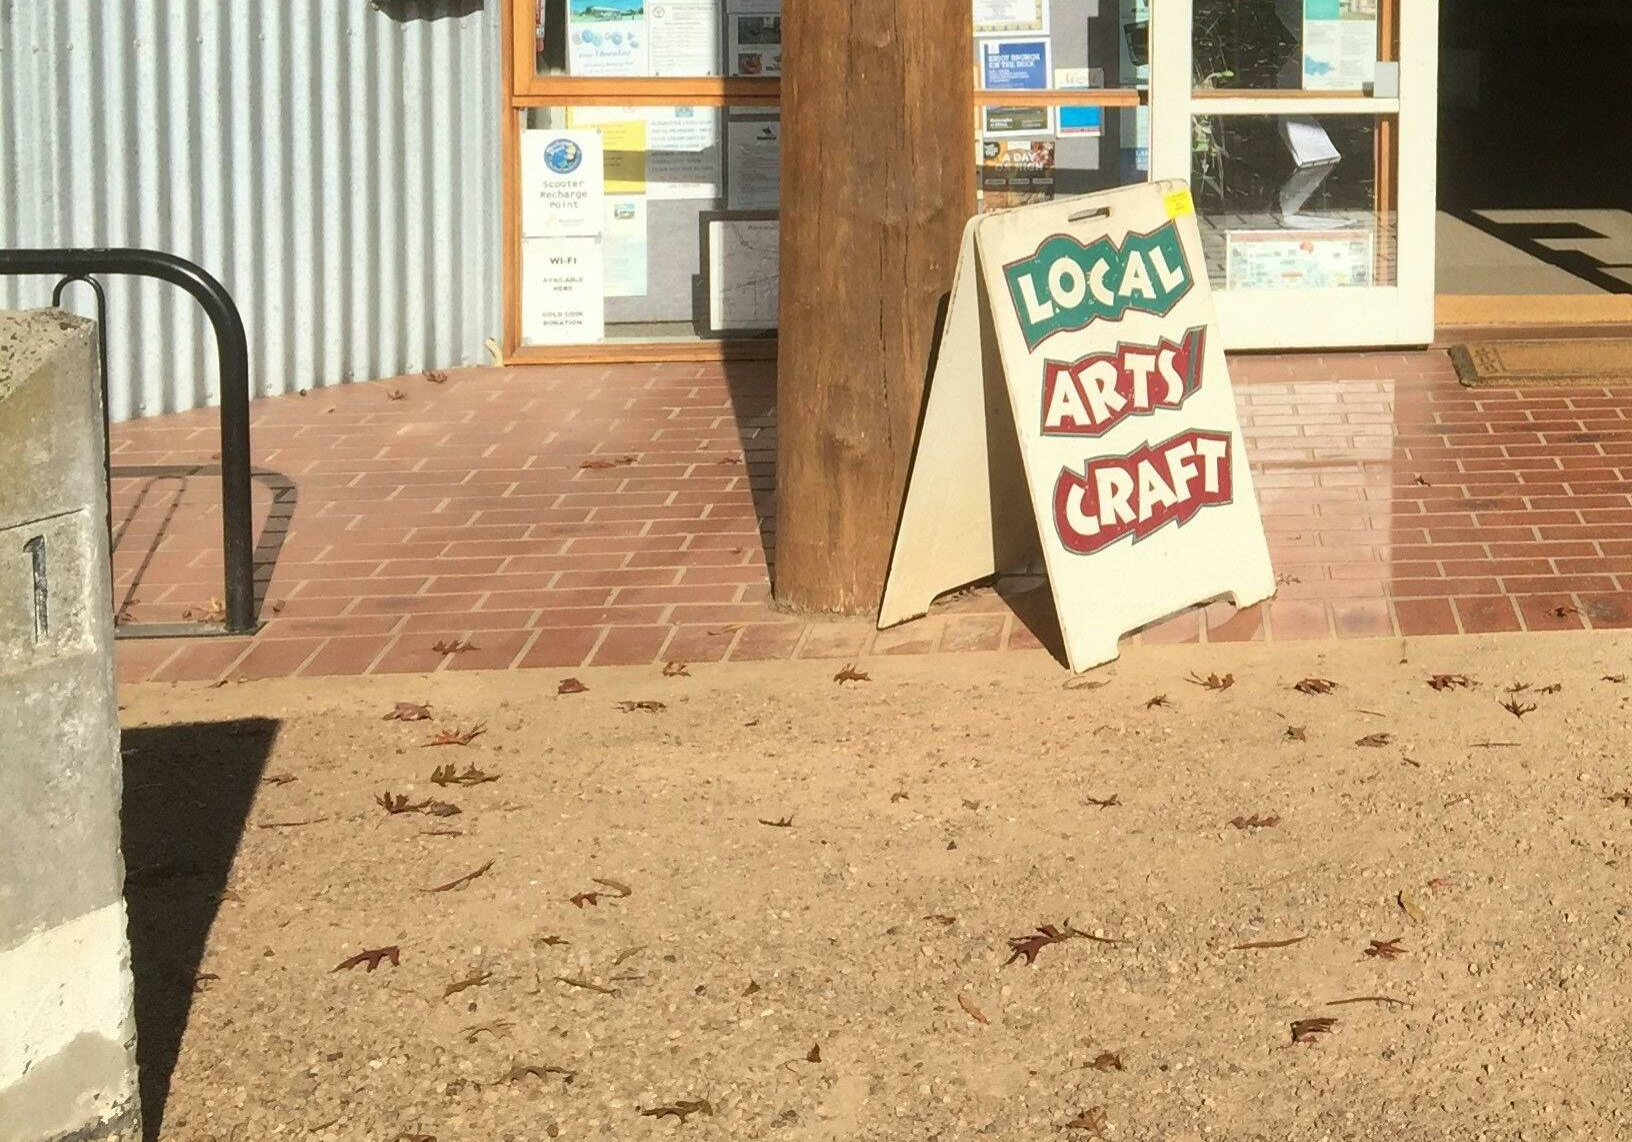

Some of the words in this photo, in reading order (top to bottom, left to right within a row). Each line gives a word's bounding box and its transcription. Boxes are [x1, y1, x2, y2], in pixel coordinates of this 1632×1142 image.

[542, 180, 584, 189] Scooter
[540, 190, 588, 200] Recharge
[549, 201, 579, 209] Point
[1017, 245, 1185, 325] LOCAL
[1066, 438, 1226, 537] CRAFT
